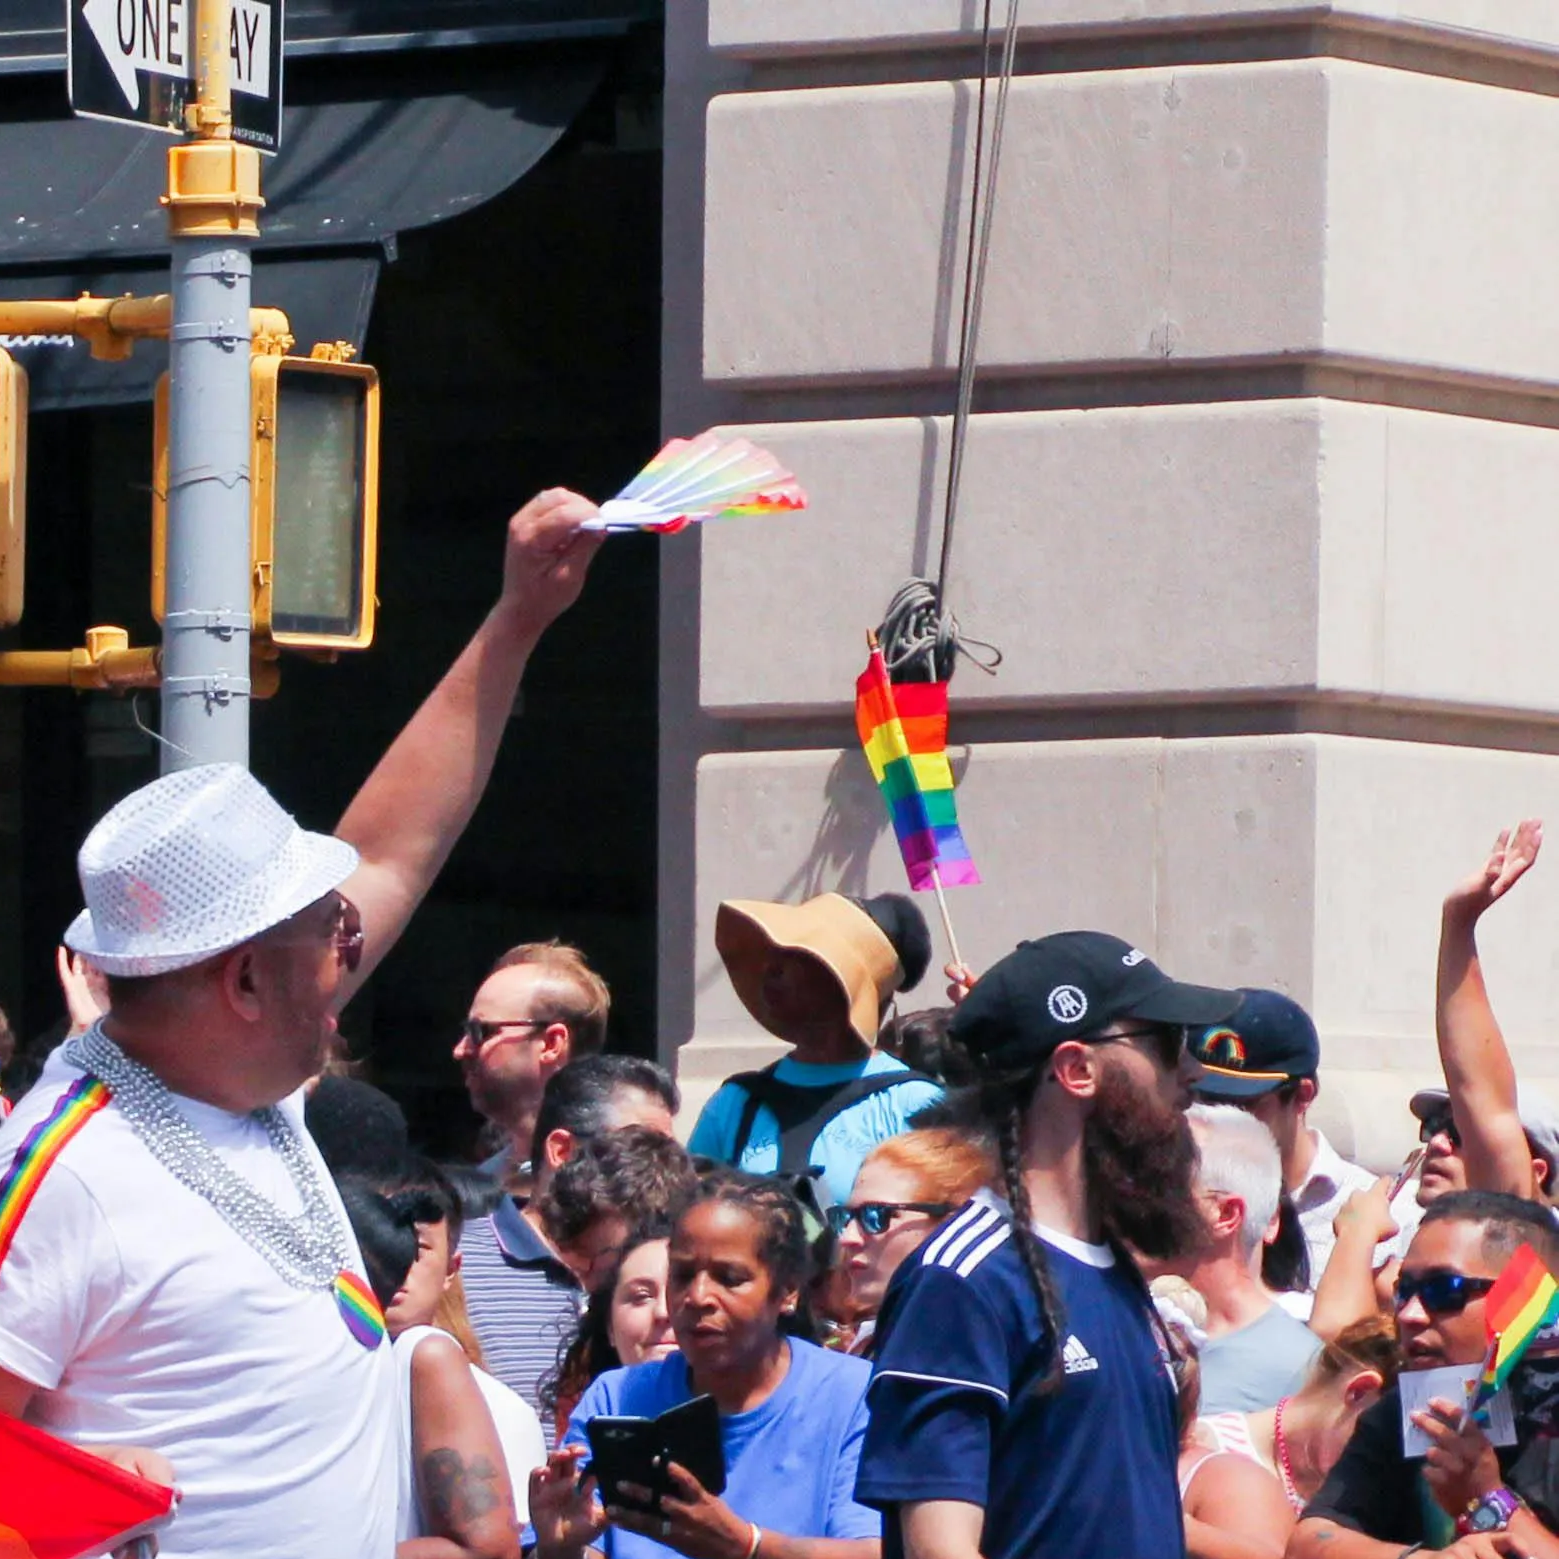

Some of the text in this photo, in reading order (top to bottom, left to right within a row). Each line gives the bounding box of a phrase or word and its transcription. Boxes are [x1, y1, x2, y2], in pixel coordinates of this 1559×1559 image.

[118, 0, 258, 82] ONE AY
[233, 127, 274, 145] ANSPORTATION
[1064, 1358, 1098, 1373] didas
